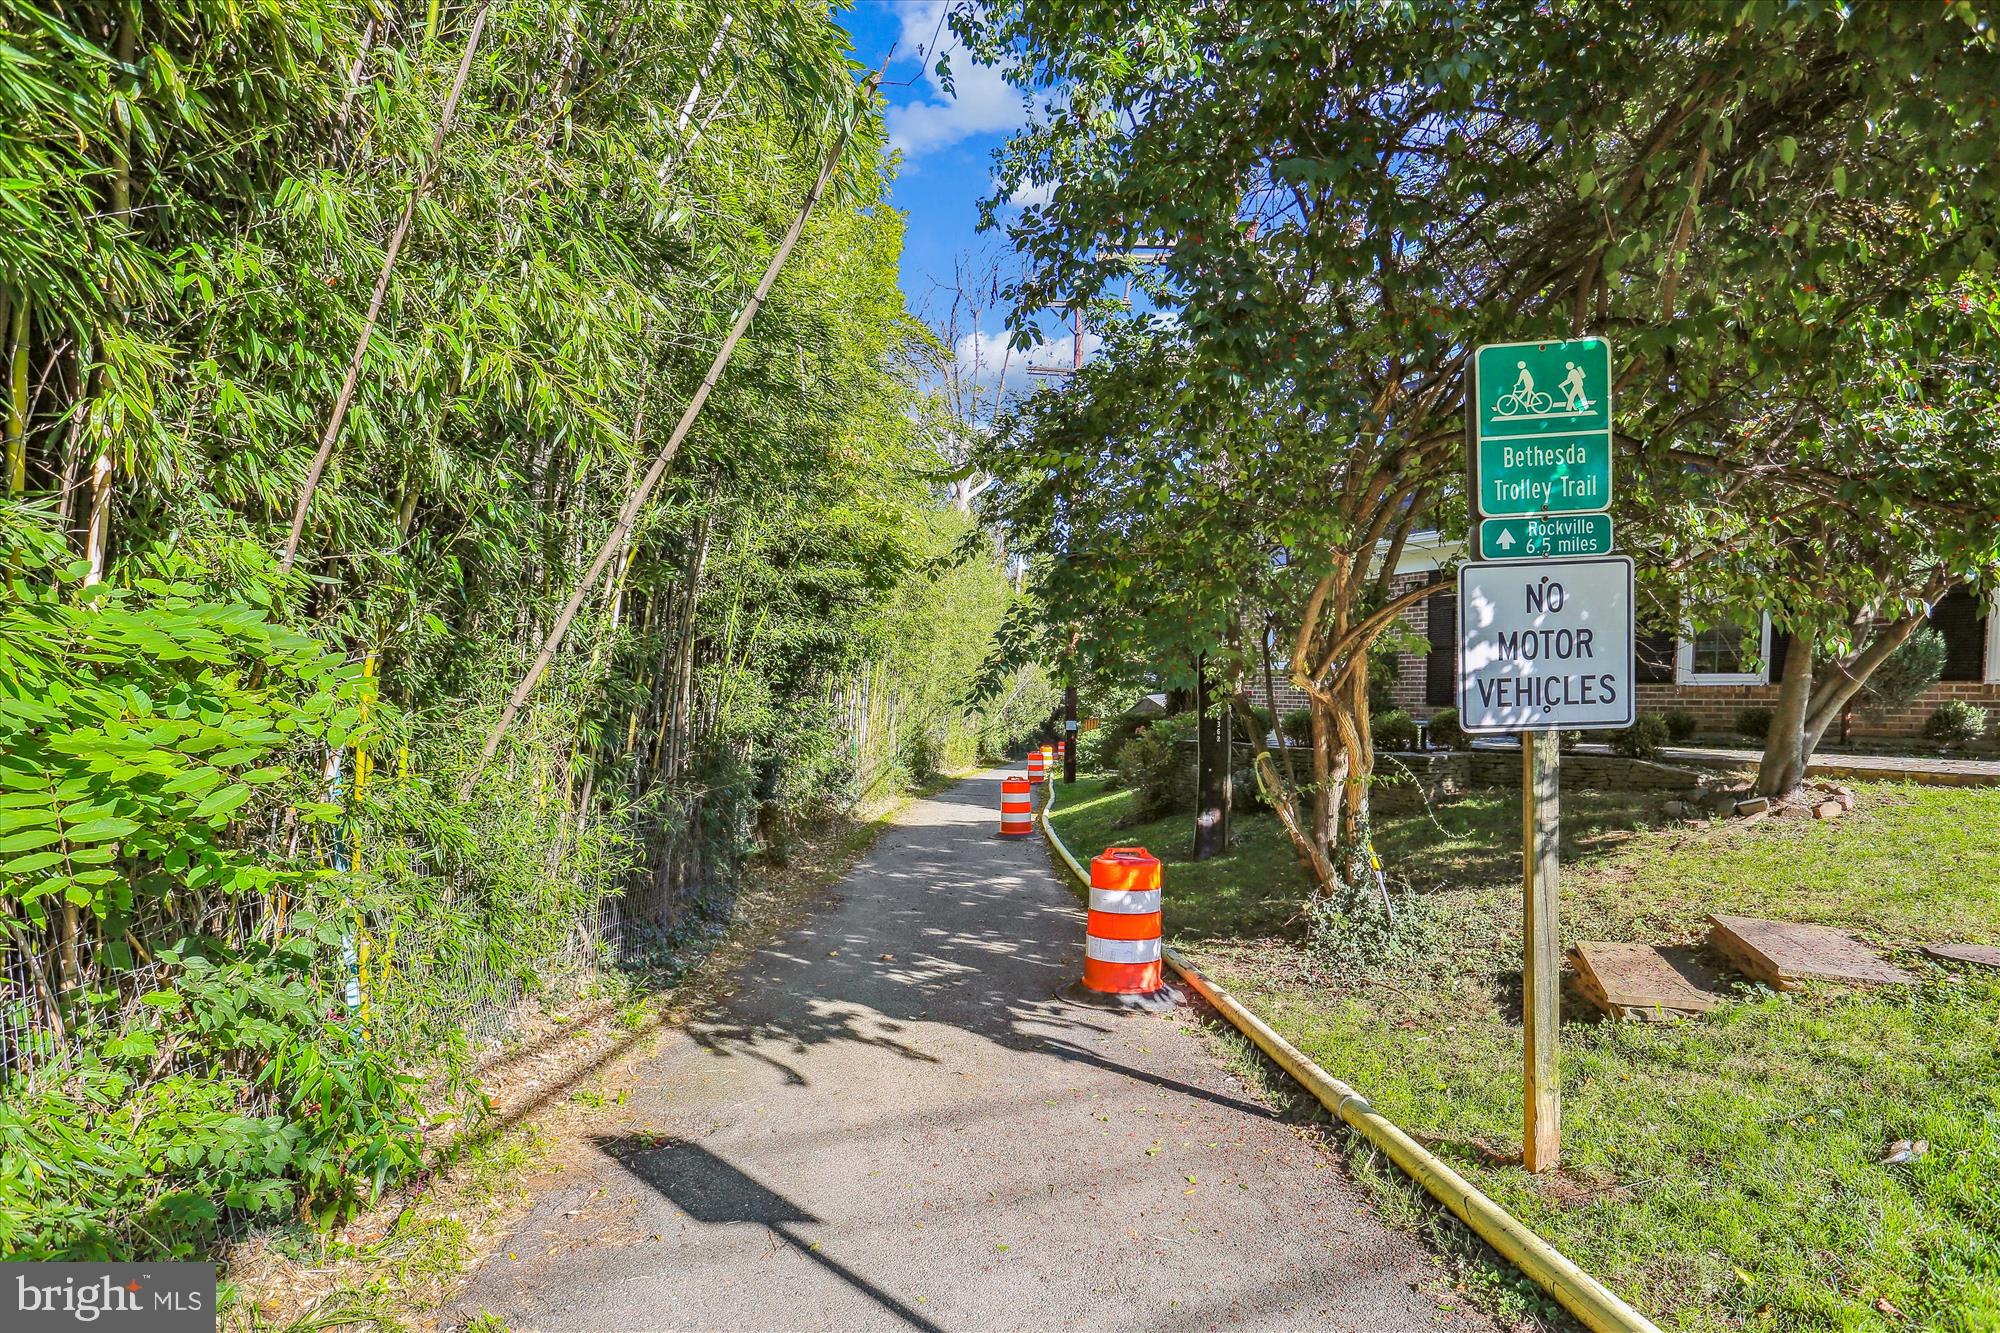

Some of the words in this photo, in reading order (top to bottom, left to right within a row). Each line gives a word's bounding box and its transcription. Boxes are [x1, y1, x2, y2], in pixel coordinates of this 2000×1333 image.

[1503, 443, 1586, 468] Bethesda
[1494, 478, 1552, 504] Trolley
[1560, 475, 1597, 497] Trail
[1528, 521, 1594, 536] Rockville
[1526, 537, 1551, 554] 6.5
[1558, 537, 1598, 553] miles
[1526, 582, 1564, 613] NO
[1498, 628, 1593, 661] MOTOR
[1477, 674, 1616, 708] VEHICLES
